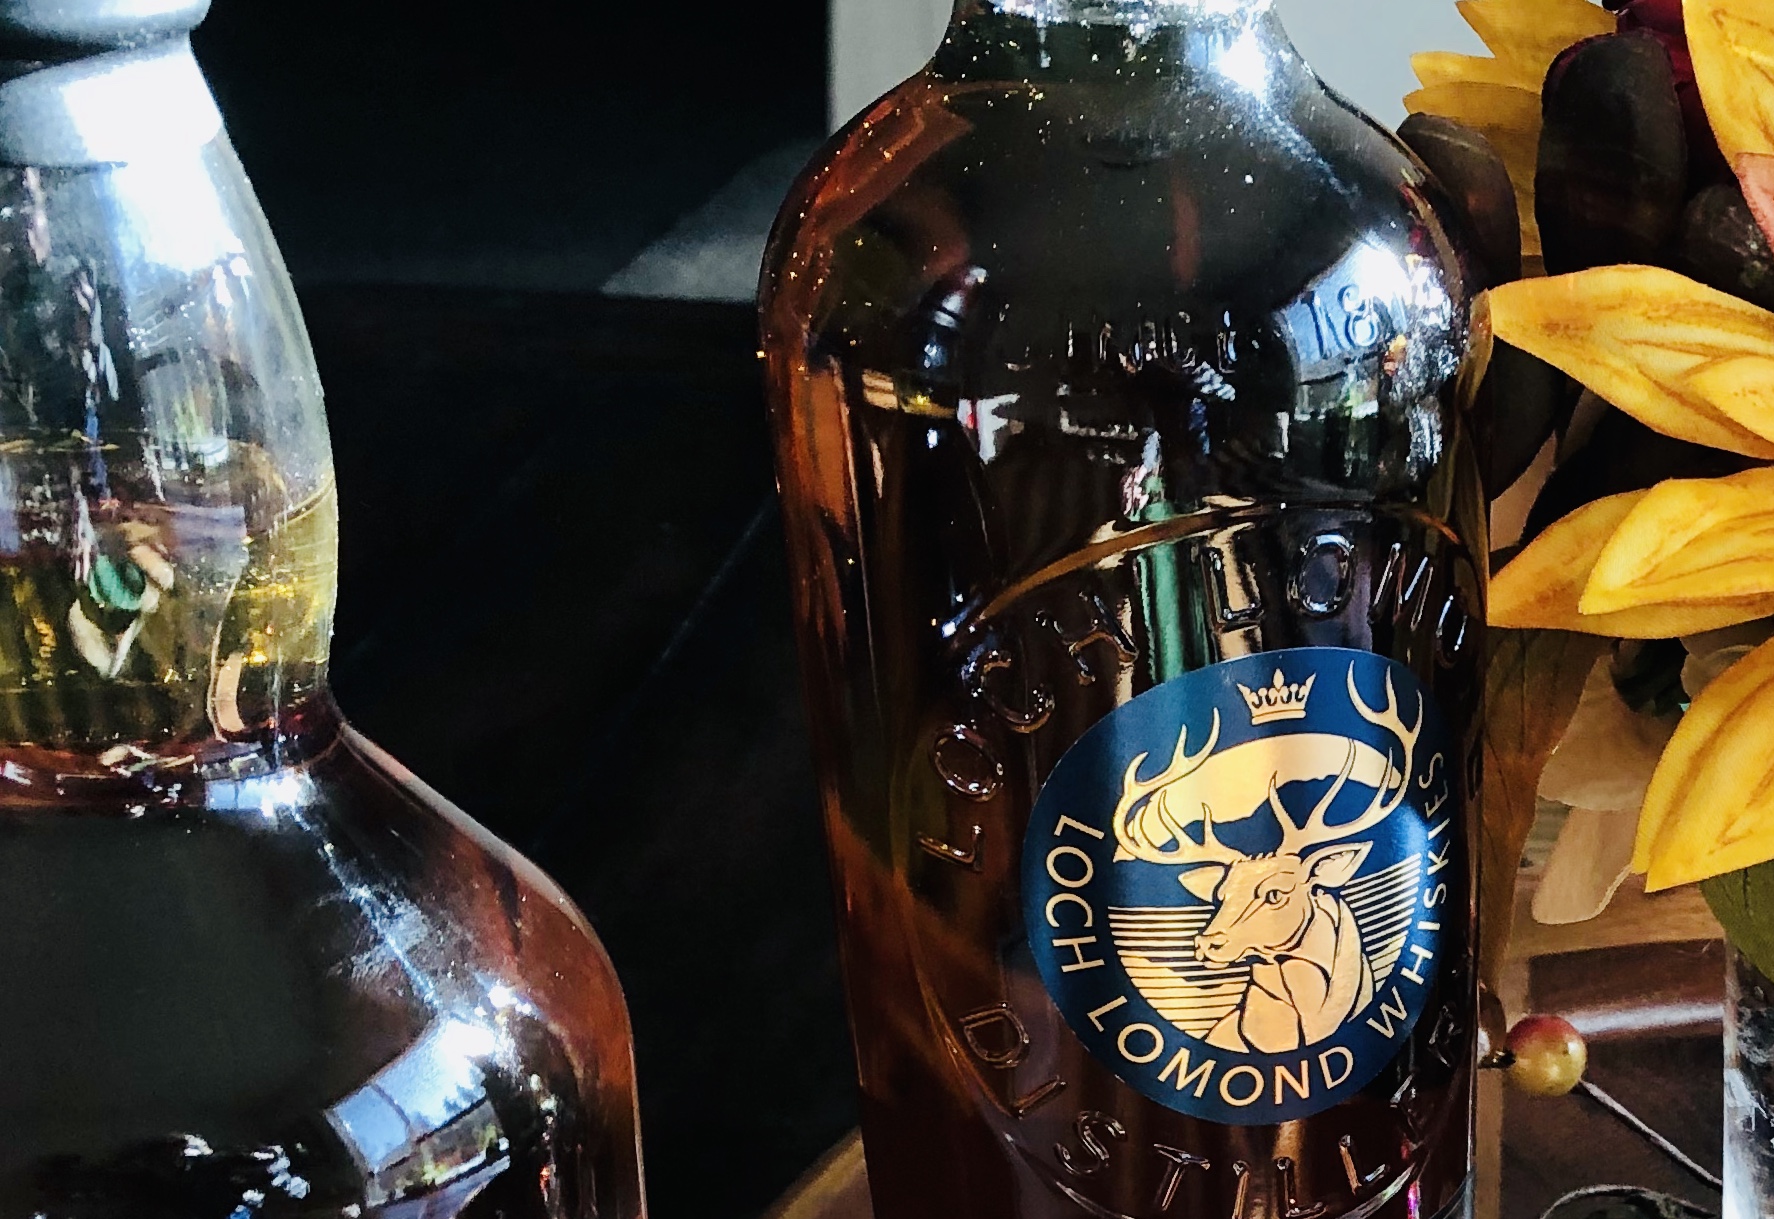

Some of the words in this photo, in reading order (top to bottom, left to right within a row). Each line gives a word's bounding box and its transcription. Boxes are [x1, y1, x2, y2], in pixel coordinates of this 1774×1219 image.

[1044, 813, 1106, 975] LOCH
[1086, 994, 1356, 1108] LOMOND
[1365, 751, 1451, 1040] WHISKIES
